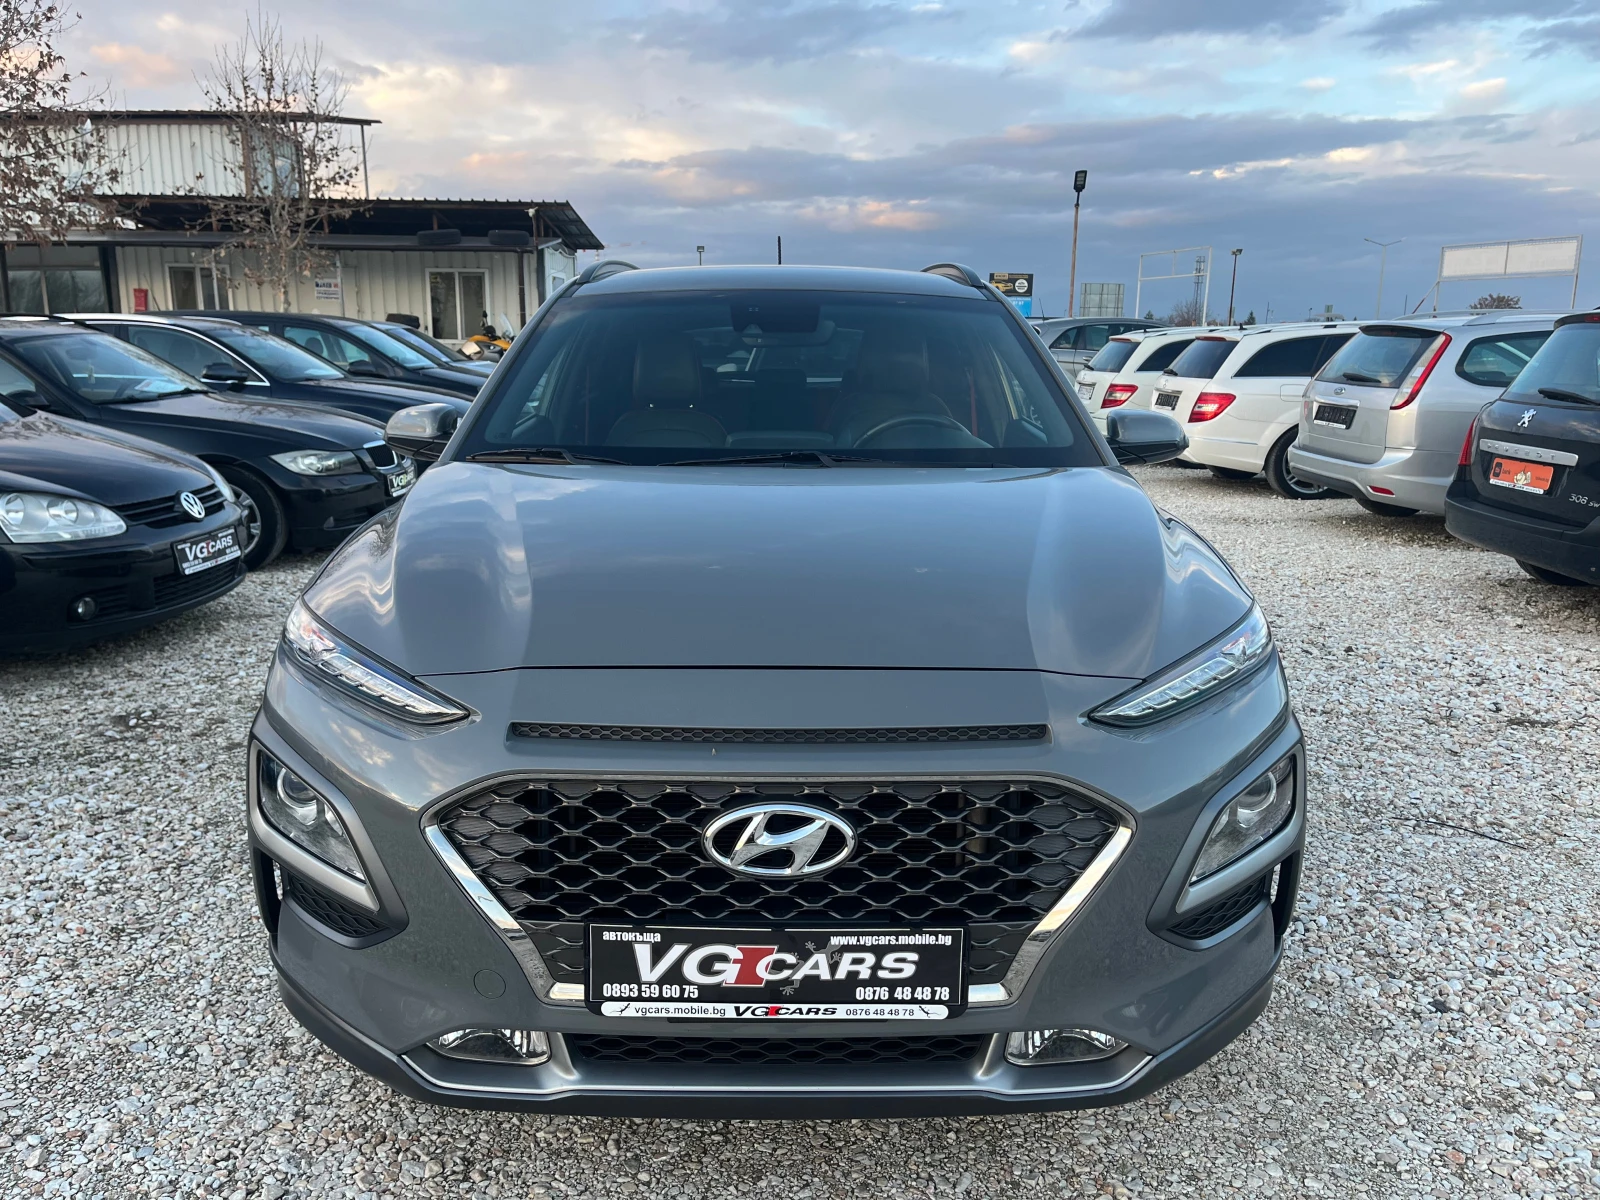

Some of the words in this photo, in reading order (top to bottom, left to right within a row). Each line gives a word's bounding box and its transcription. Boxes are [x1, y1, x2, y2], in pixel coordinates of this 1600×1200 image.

[1569, 493, 1588, 504] 308
[602, 931, 661, 943] автокъща
[830, 934, 952, 946] www.vgcars.mobile.bg
[602, 983, 639, 998] 0893
[641, 984, 660, 998] 59
[662, 984, 681, 998] 60
[682, 985, 699, 999] 75
[855, 986, 889, 1001] 0876
[893, 986, 912, 1001] 48
[914, 986, 932, 1001] 48
[933, 986, 950, 1001] 78
[634, 1005, 726, 1017] vgcars.mobile.bg
[845, 1008, 871, 1017] 0876
[872, 1008, 885, 1017] 48
[887, 1008, 900, 1017] 48
[902, 1008, 915, 1017] 78
